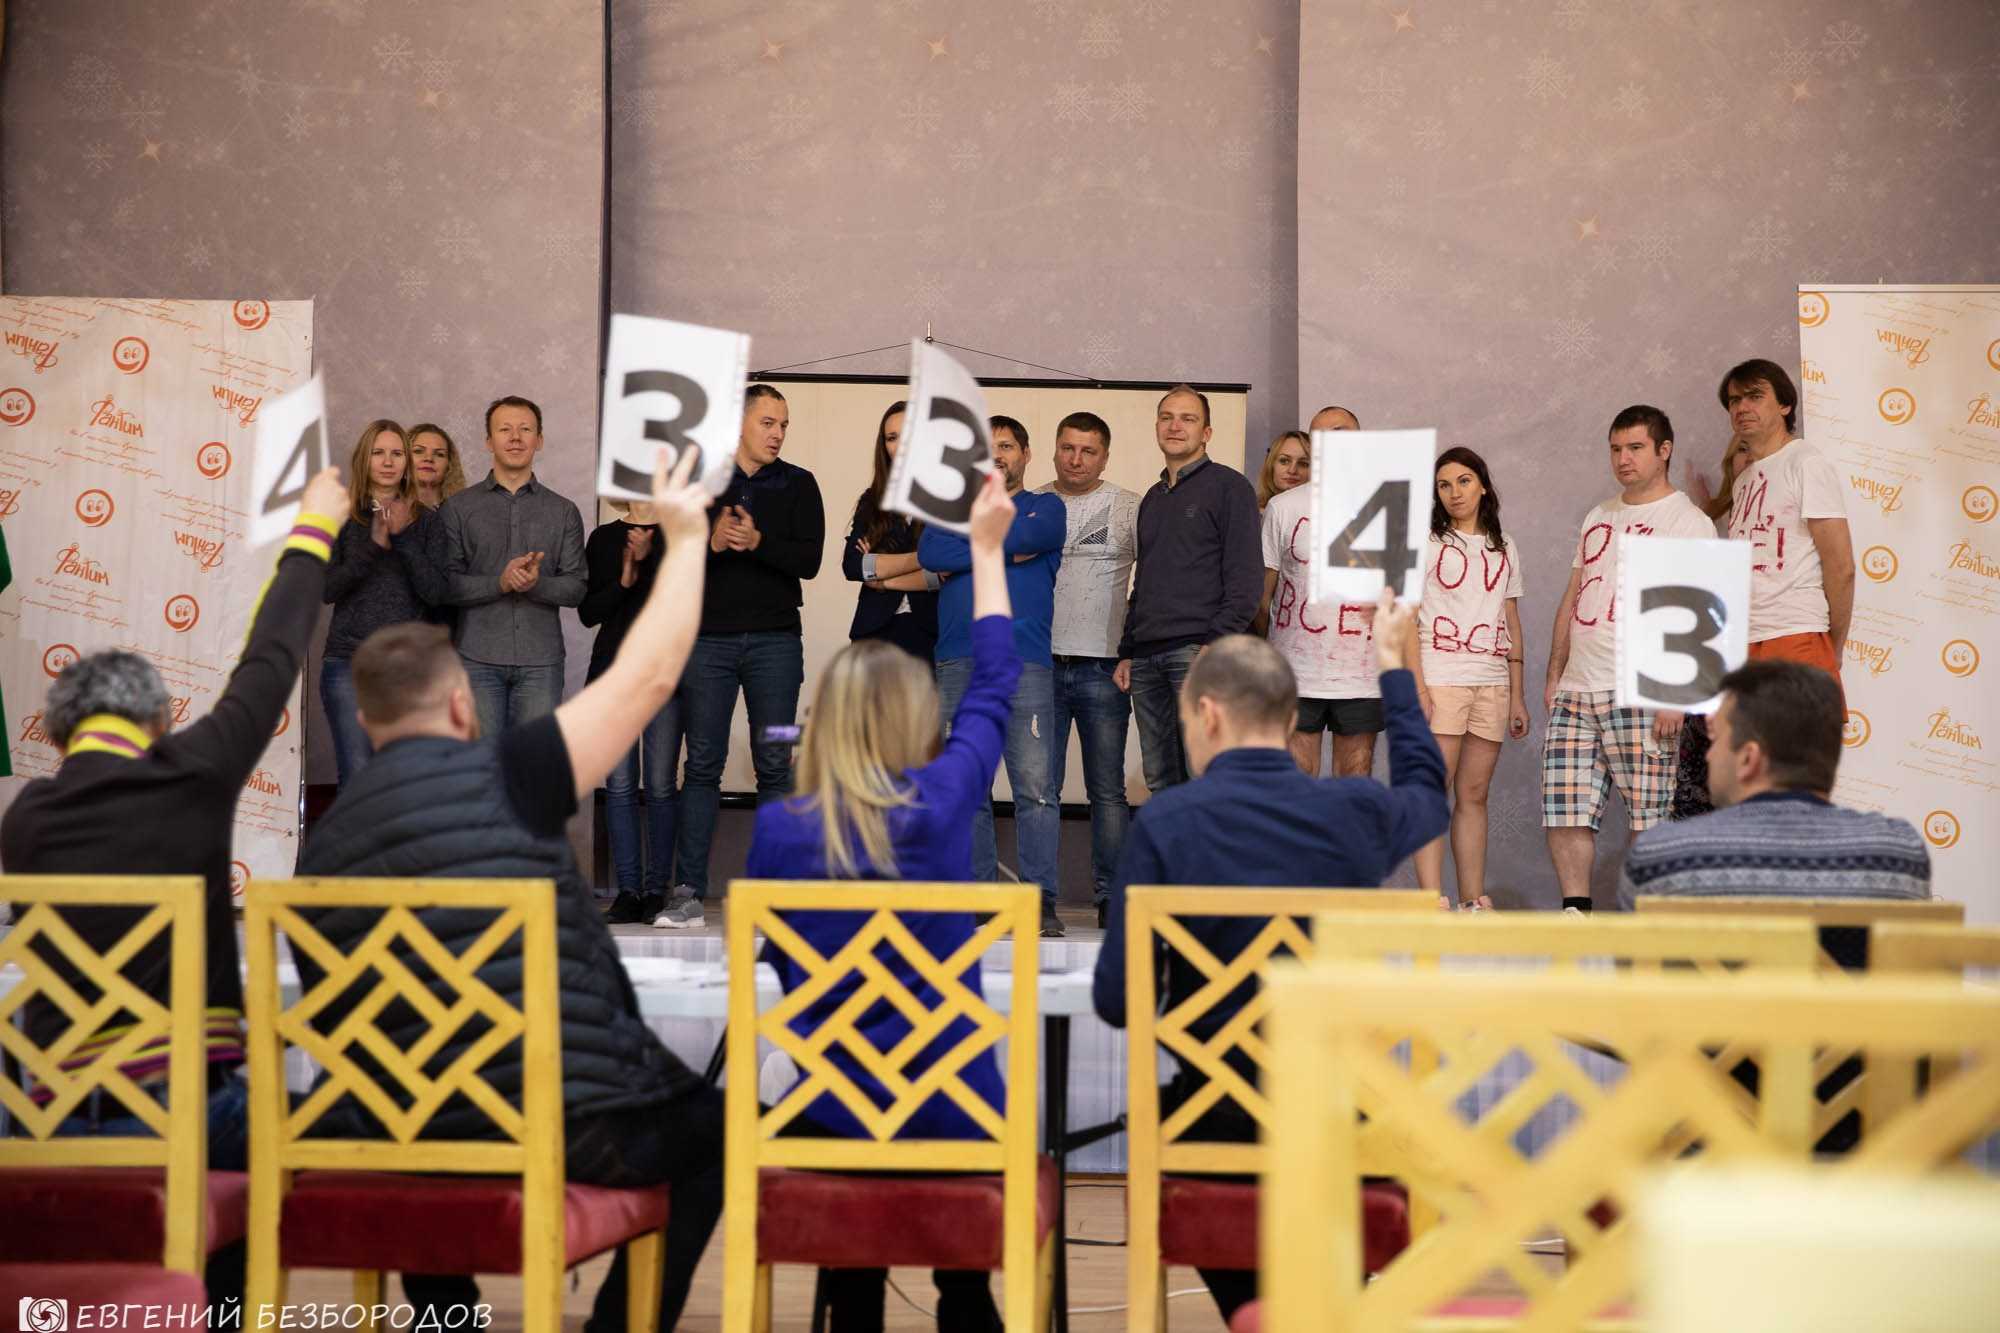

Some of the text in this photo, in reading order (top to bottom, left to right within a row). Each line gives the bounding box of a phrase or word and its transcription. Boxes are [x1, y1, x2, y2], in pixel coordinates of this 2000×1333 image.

[262, 417, 322, 516] 4
[612, 370, 709, 496] 3
[909, 396, 993, 523] 3
[1328, 480, 1420, 596] 4
[1636, 585, 1728, 705] 3
